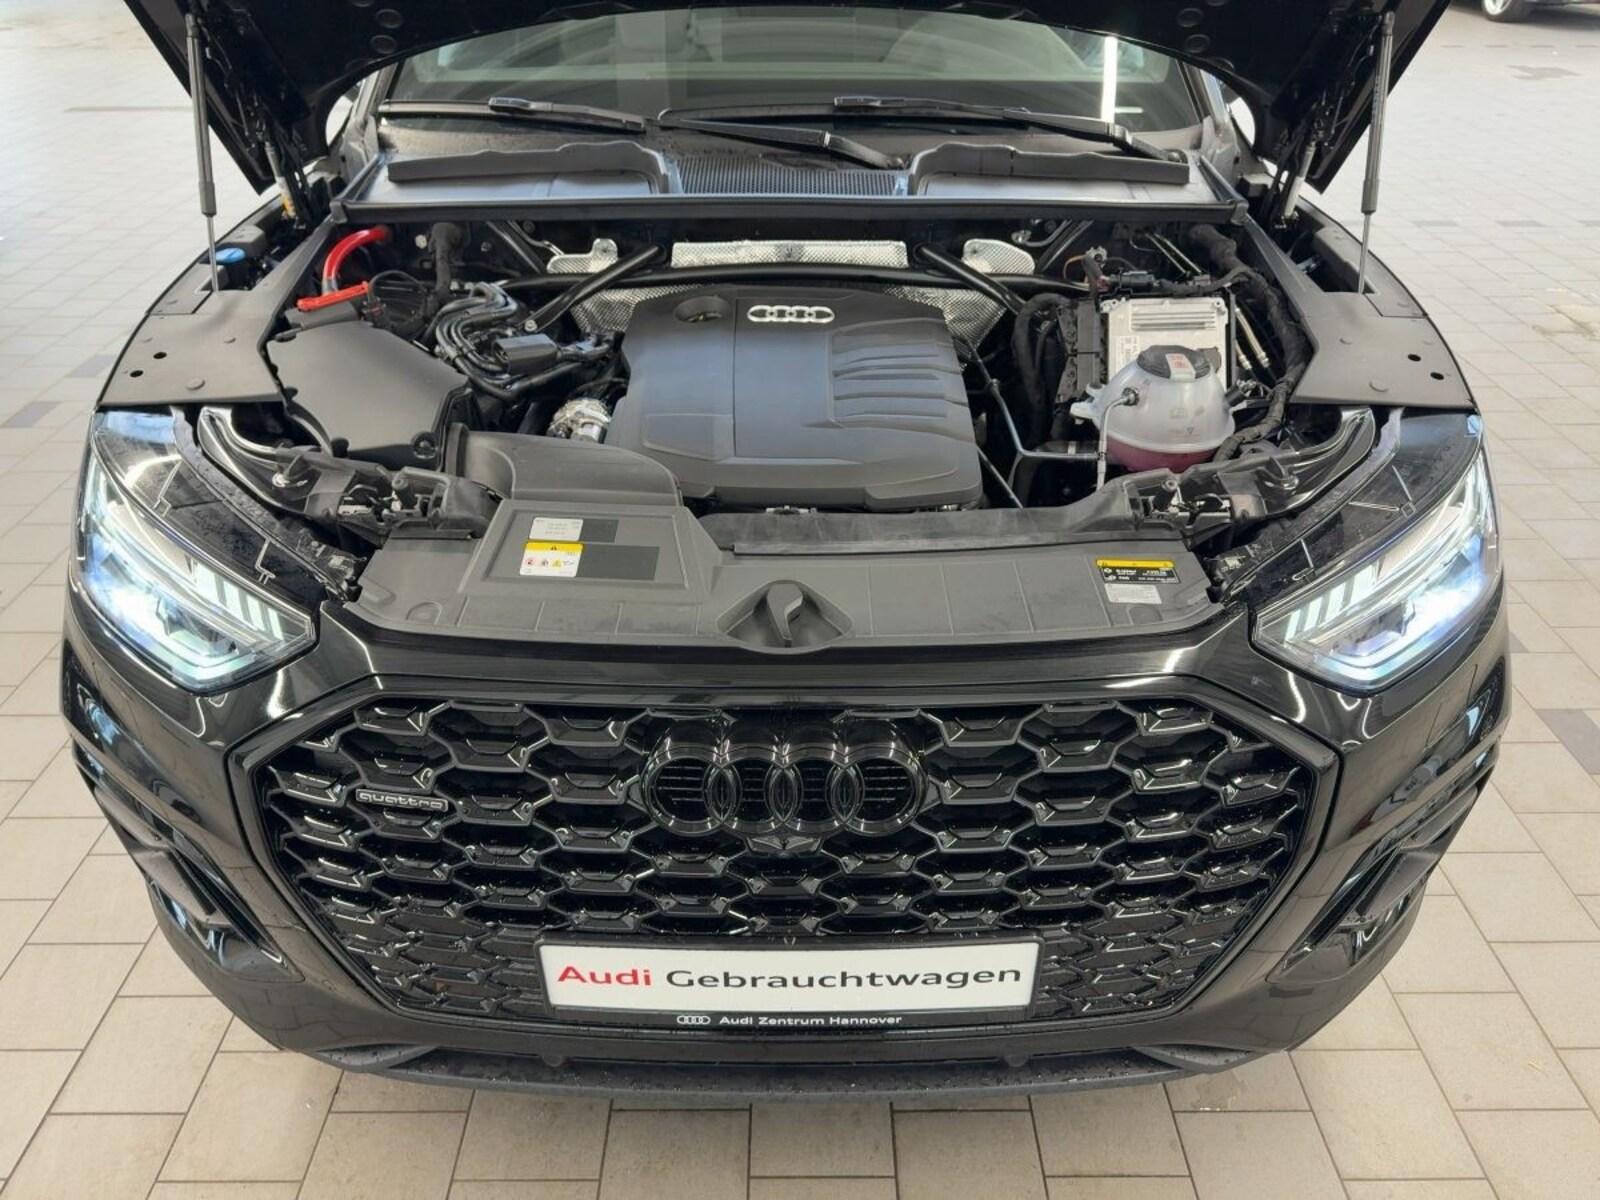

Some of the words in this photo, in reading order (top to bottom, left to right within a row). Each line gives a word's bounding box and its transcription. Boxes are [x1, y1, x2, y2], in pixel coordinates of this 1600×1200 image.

[358, 792, 443, 809] quattro
[557, 965, 652, 986] Audi
[666, 969, 1021, 989] Gebrauchtwagen
[719, 1016, 753, 1025] Audi
[758, 1016, 825, 1026] Zentrum
[829, 1015, 902, 1025] Hannover
